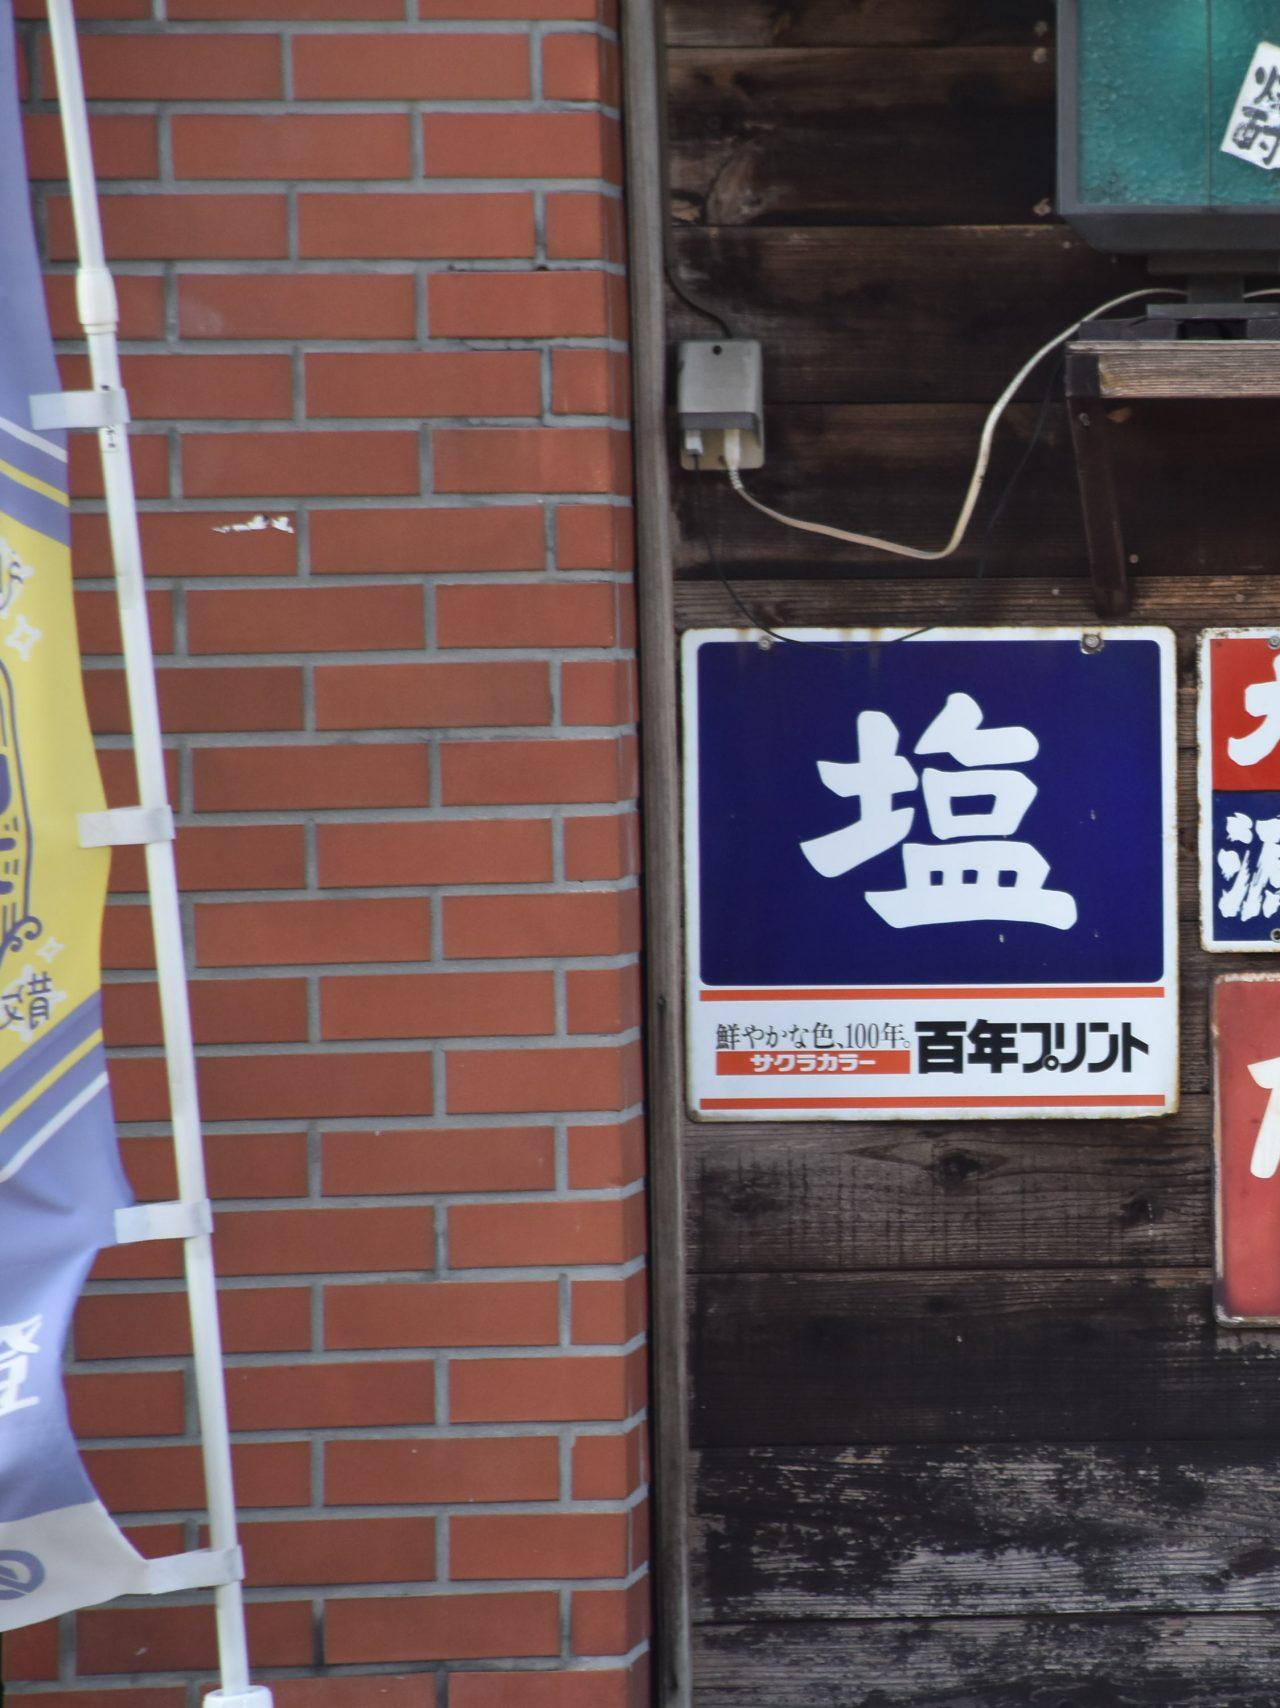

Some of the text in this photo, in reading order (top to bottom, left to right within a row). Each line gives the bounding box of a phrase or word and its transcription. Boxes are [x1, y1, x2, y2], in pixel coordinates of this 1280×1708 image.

[799, 691, 1079, 931] 塩
[750, 1053, 877, 1073] サクラカラー
[914, 1018, 1149, 1074] 百年プリント
